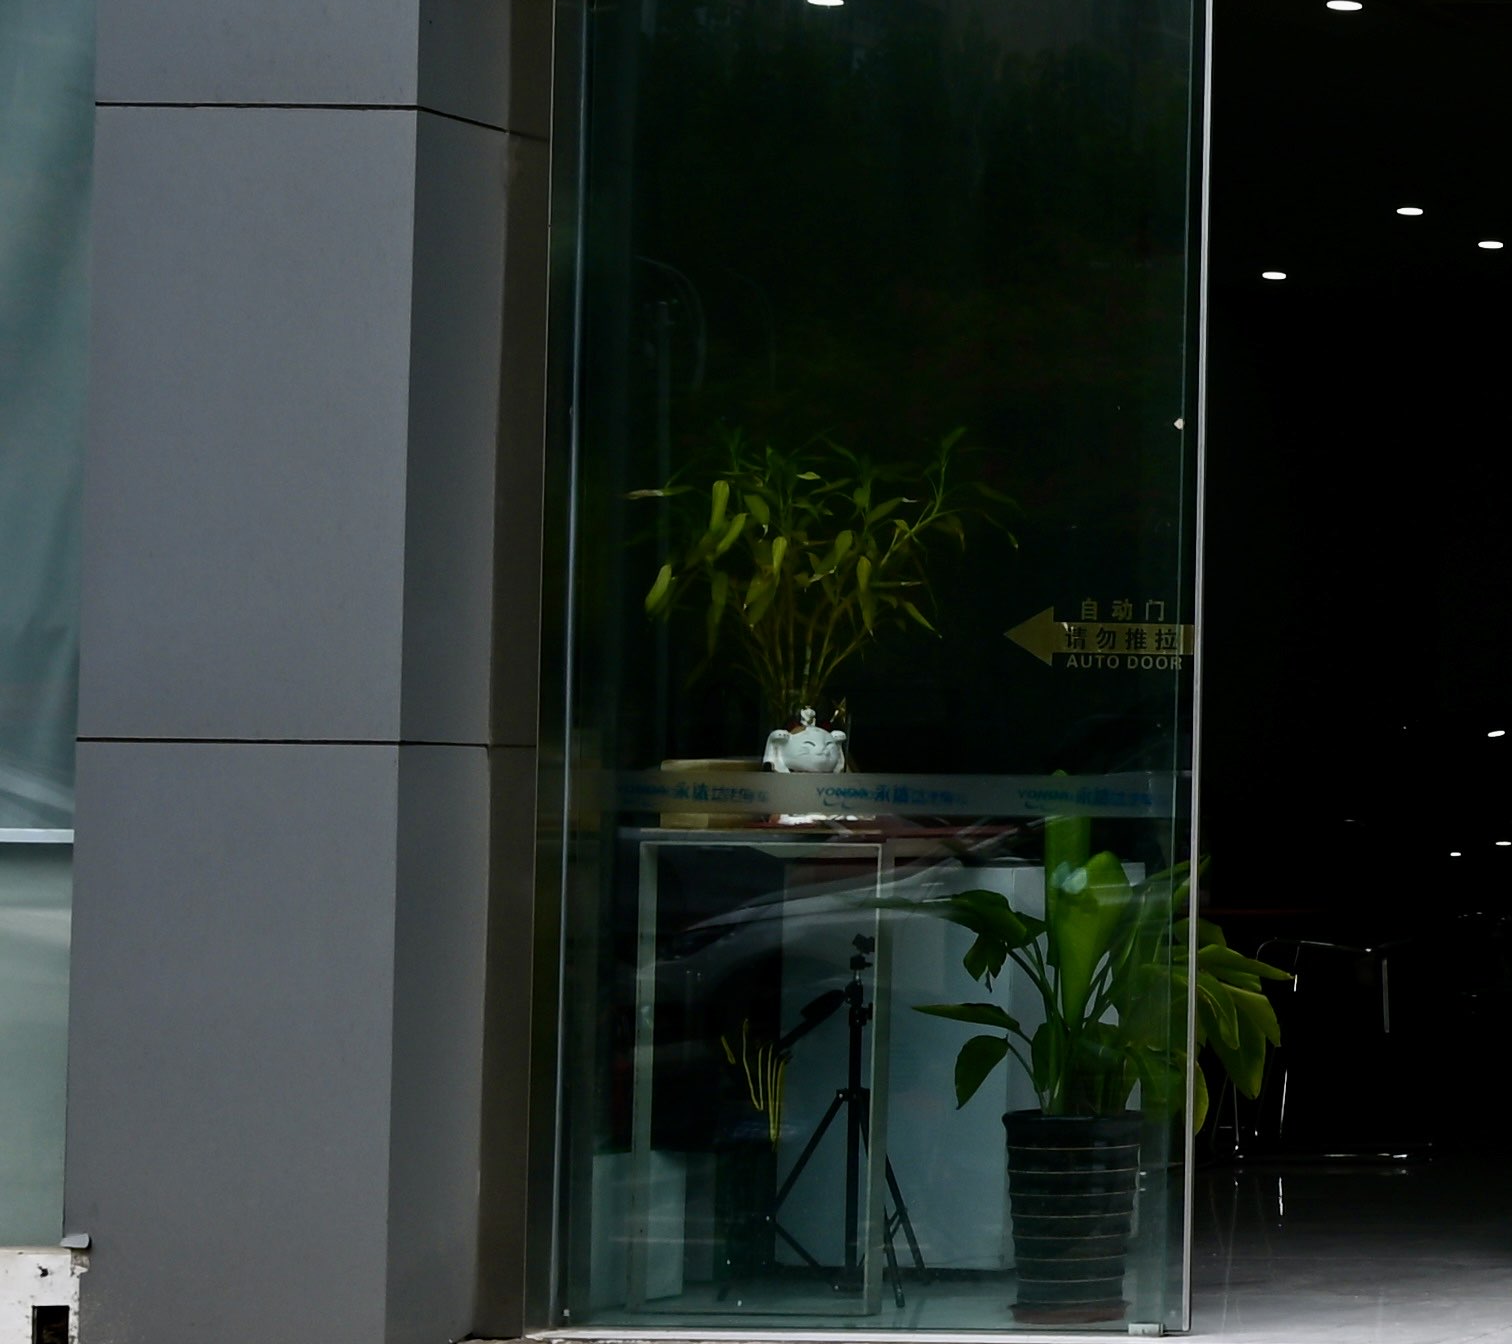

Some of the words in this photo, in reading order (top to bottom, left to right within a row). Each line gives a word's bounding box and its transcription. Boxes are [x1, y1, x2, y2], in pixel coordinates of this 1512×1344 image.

[1081, 598, 1165, 622] 自动门
[1065, 627, 1179, 651] 请勿推拉
[1066, 654, 1120, 669] AUTO
[1127, 656, 1183, 670] DOOR
